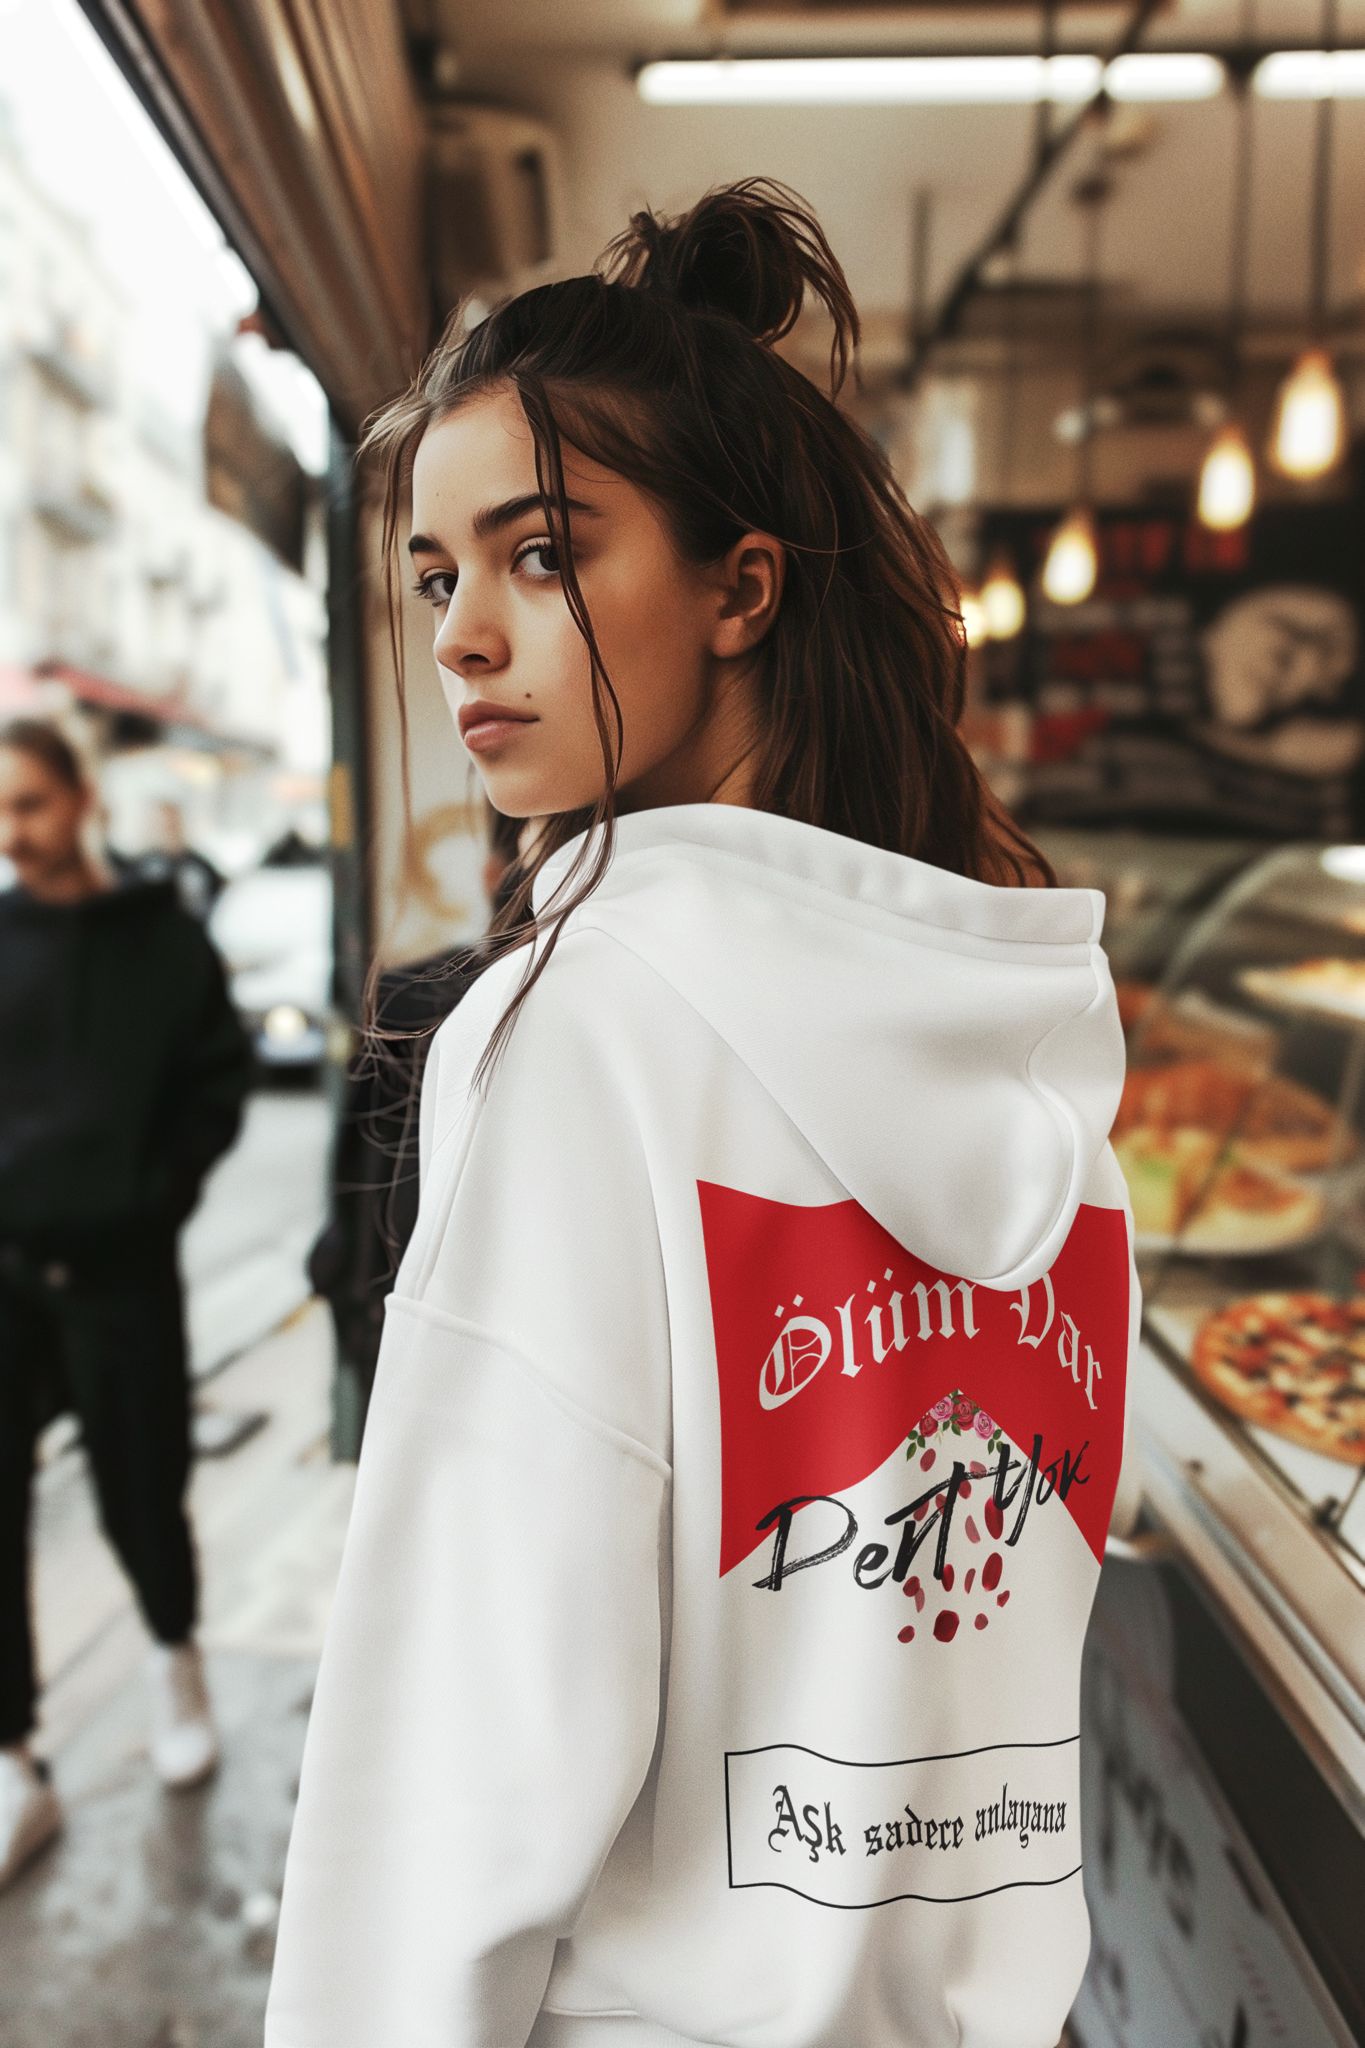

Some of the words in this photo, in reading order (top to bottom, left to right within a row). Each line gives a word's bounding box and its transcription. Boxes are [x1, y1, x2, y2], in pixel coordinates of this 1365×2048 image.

[758, 1267, 980, 1411] Ölüm
[768, 1784, 846, 1863] Aşk
[864, 1803, 964, 1857] sadece
[974, 1782, 1067, 1849] anlayana
